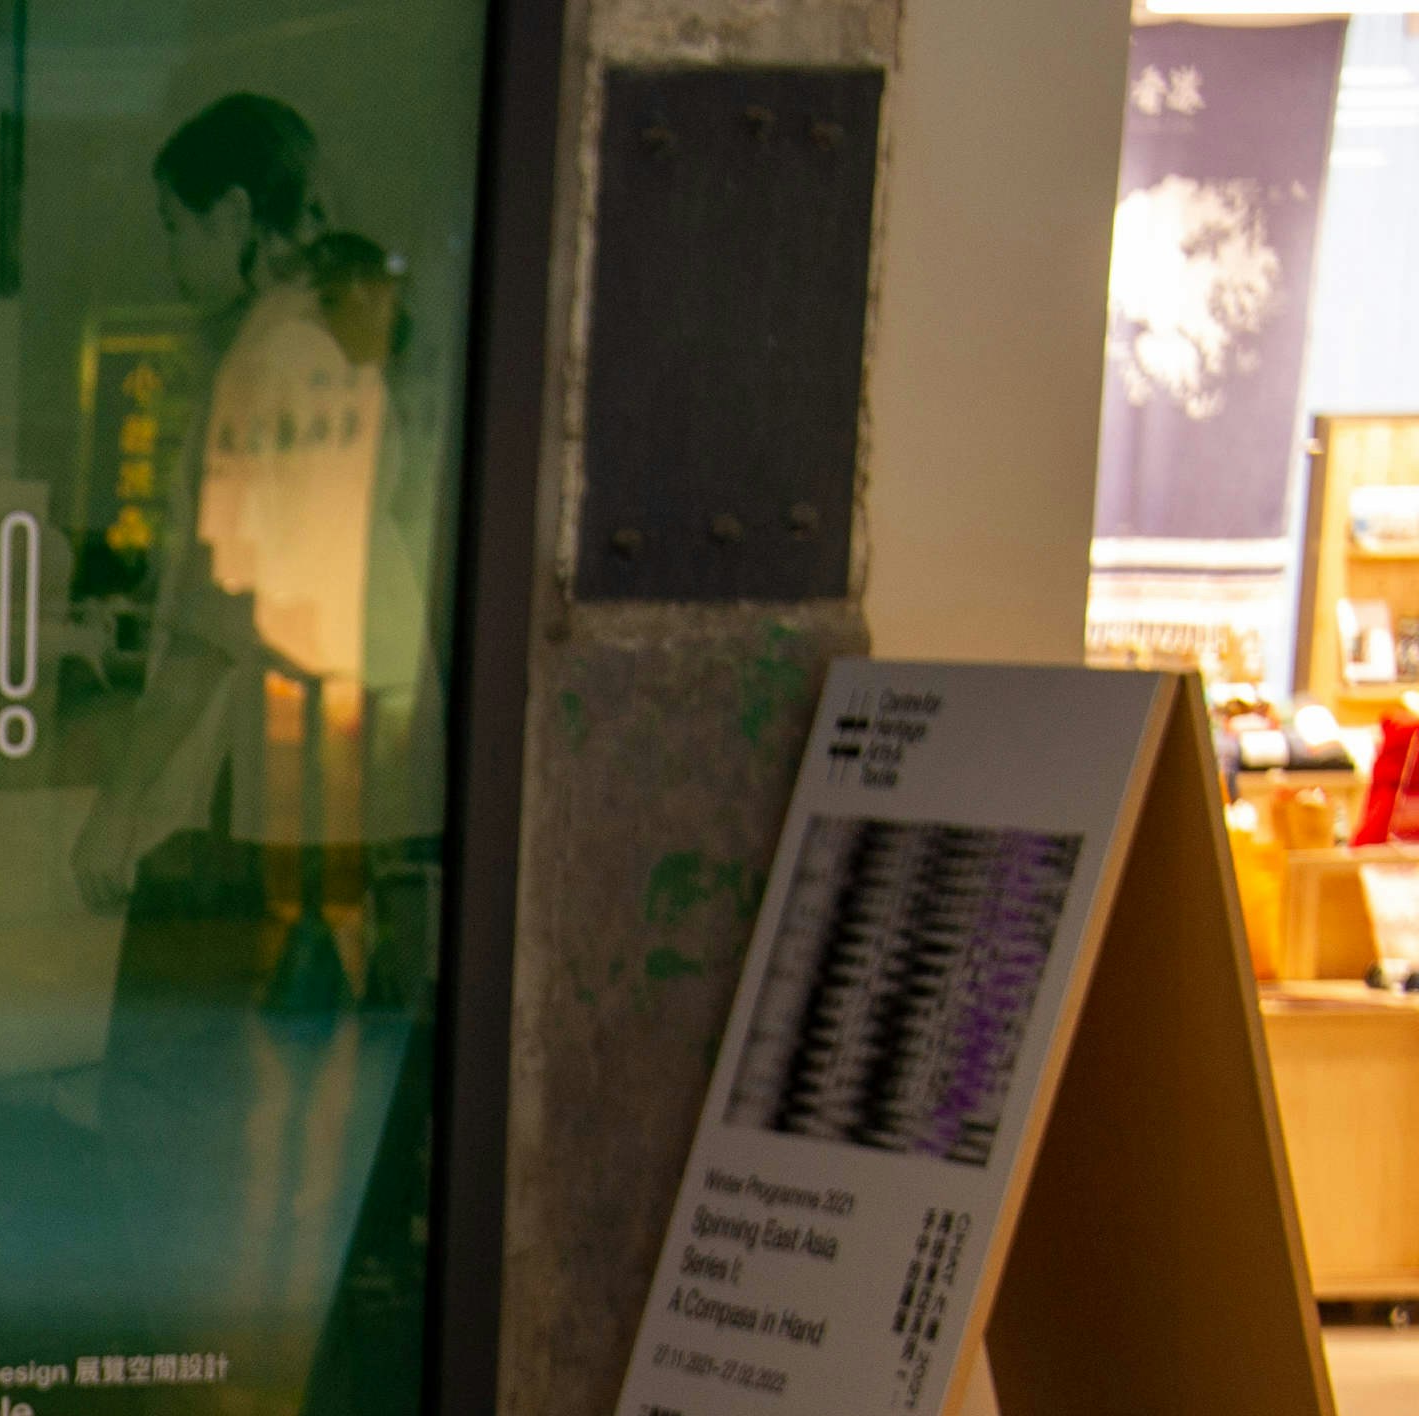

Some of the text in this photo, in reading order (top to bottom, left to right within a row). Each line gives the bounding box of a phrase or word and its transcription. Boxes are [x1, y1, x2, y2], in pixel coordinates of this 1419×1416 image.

[692, 1206, 839, 1262] Spinning East Asia
[682, 1246, 729, 1280] Series
[669, 1287, 826, 1348] A Compass in Hand
